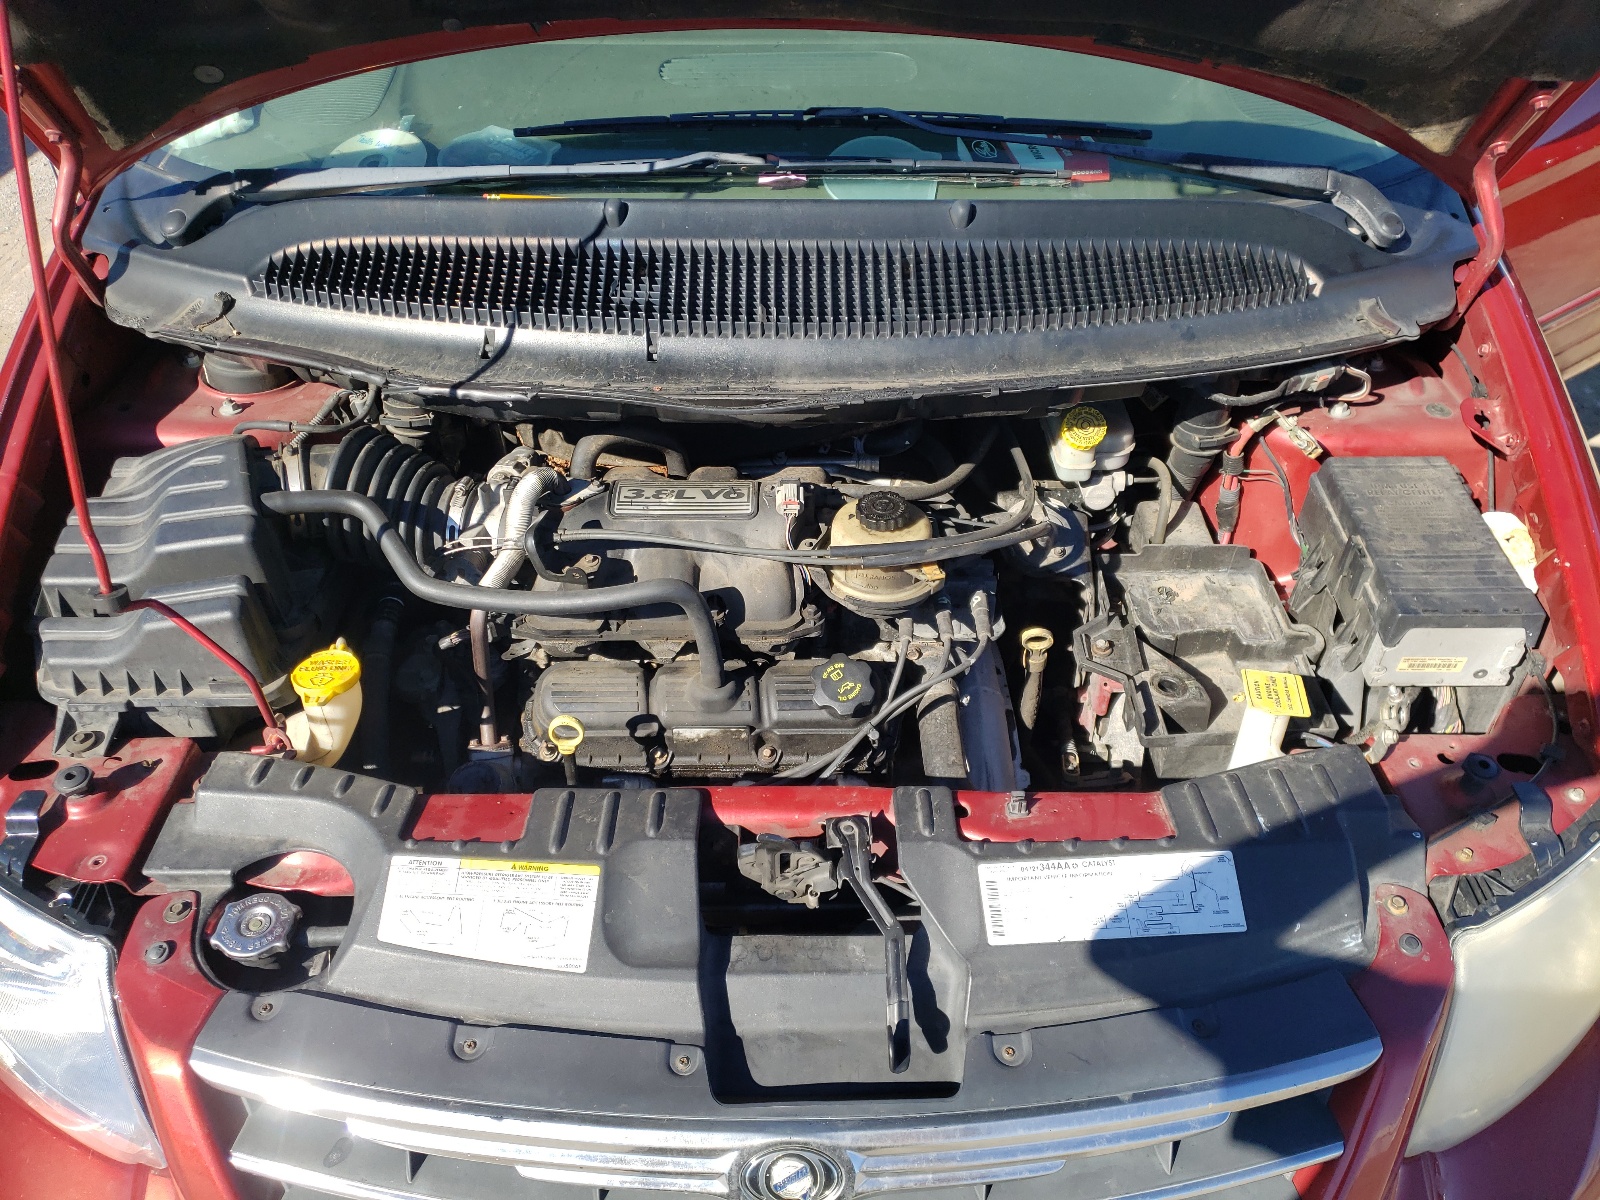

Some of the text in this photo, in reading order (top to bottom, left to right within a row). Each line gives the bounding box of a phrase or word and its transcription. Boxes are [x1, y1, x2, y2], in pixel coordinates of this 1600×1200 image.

[1027, 144, 1046, 161] MICR
[623, 487, 746, 500] 3.8L V6
[1253, 680, 1263, 700] CAUTION
[1264, 682, 1274, 700] ENGINE
[1270, 675, 1282, 708] COOLANT ONLY
[408, 859, 443, 867] ATTENTION
[518, 864, 550, 872] WARNING
[1081, 859, 1116, 868] CATALYST
